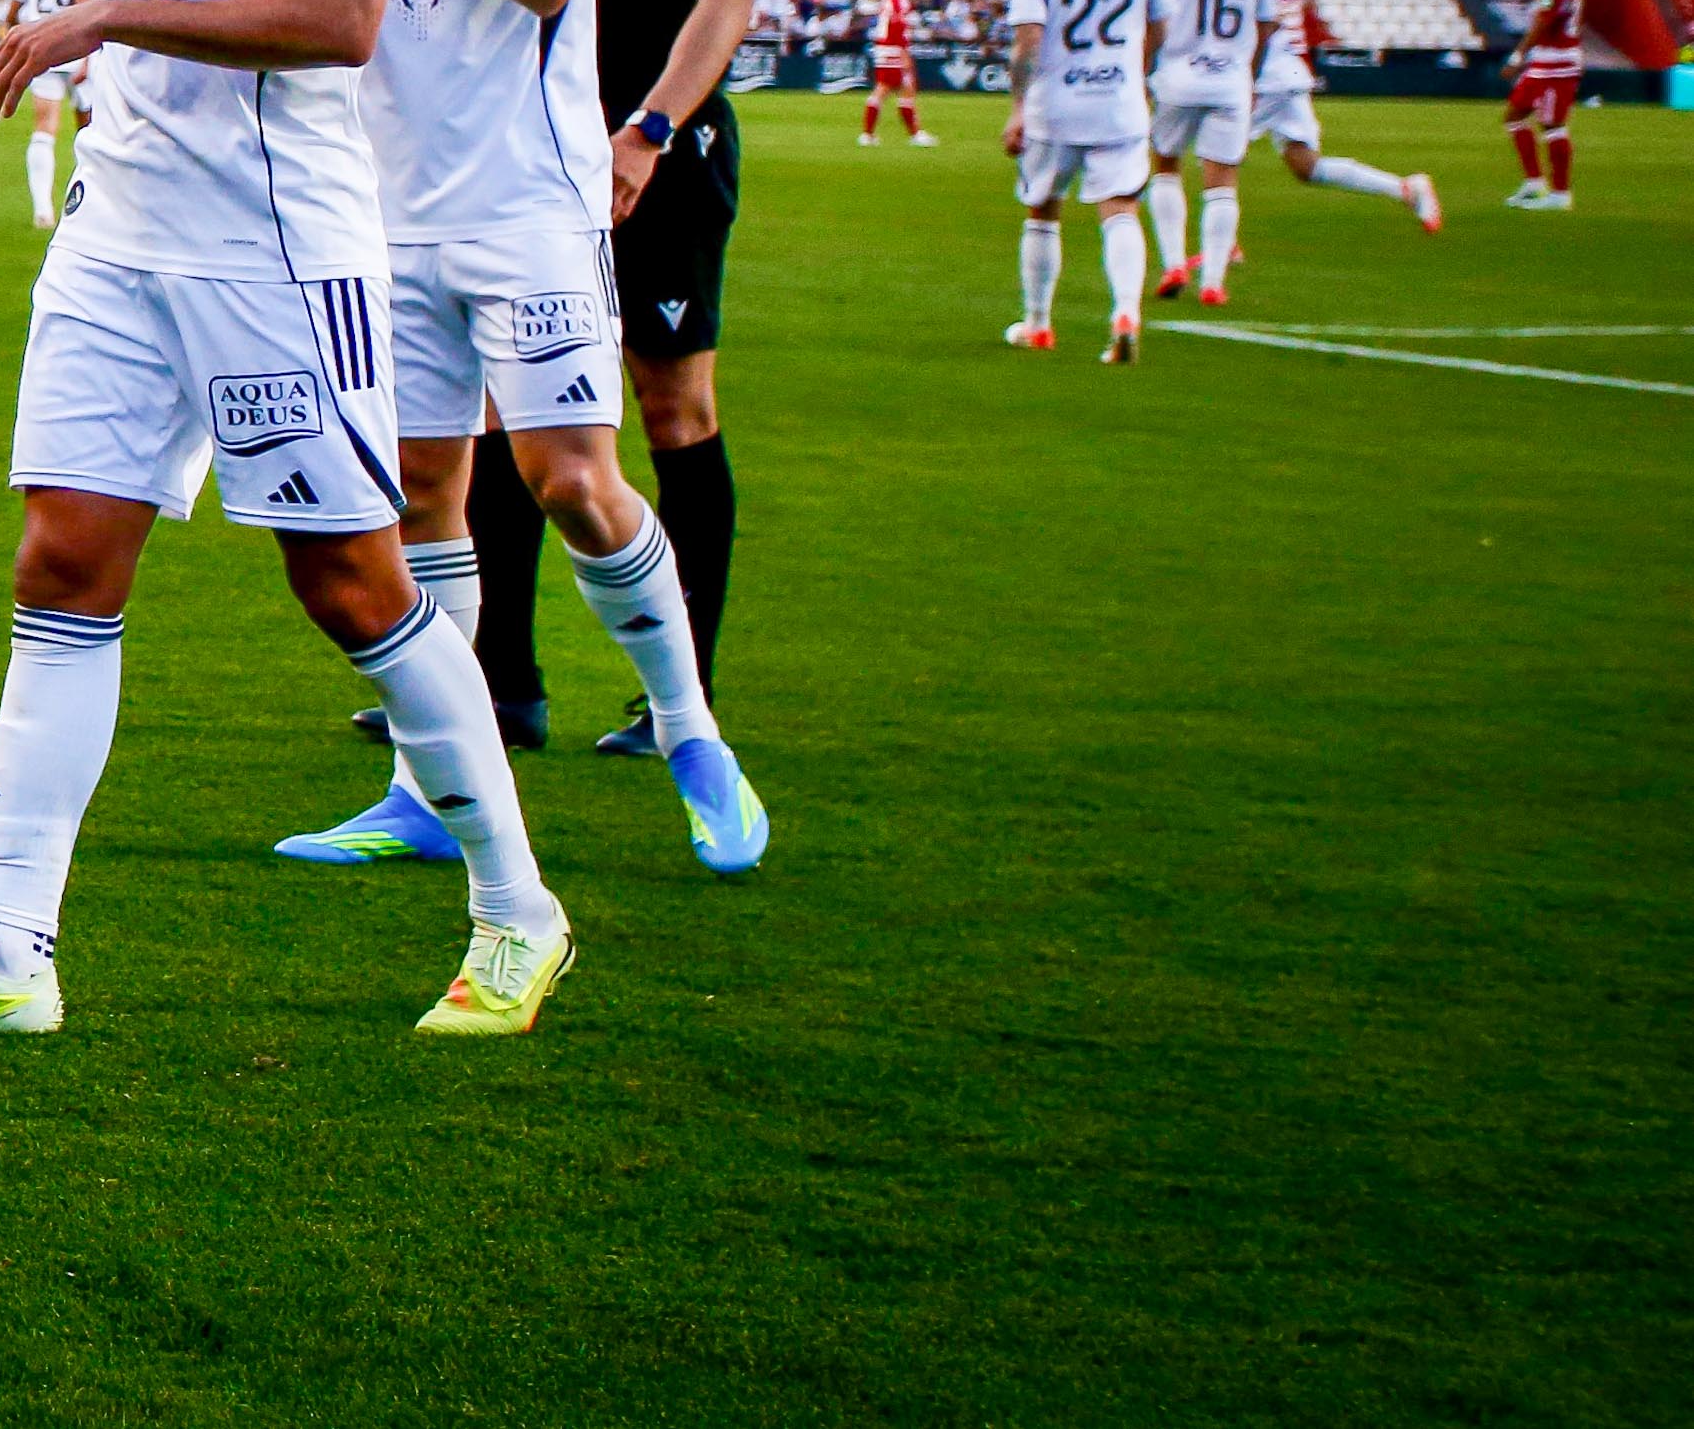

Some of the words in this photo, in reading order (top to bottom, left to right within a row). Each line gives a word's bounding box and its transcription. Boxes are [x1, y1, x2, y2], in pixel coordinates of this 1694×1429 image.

[520, 299, 592, 318] AQUA
[525, 319, 593, 337] DEUS
[220, 380, 308, 406] AQUA
[225, 404, 307, 426] DEUS
